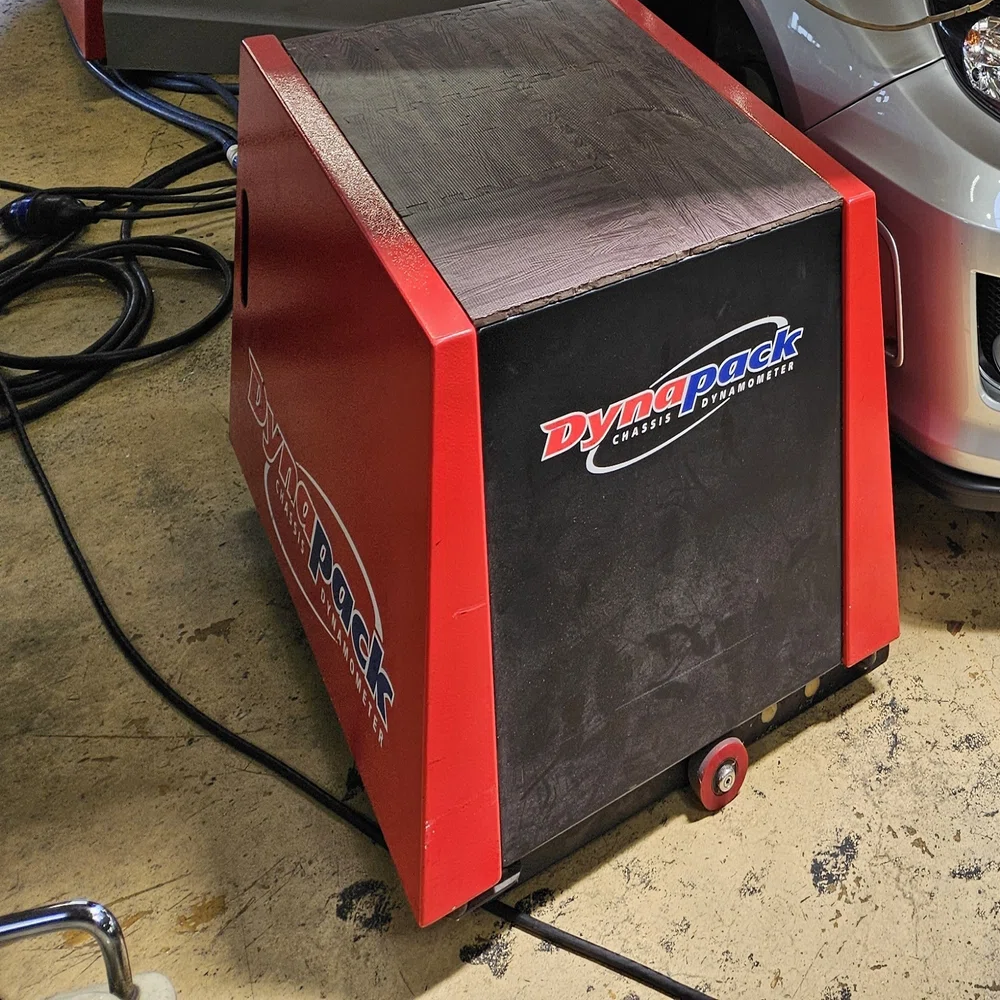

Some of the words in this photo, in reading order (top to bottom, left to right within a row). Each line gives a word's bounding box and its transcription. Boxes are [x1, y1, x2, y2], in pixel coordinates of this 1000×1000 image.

[541, 326, 804, 463] Dynapack
[613, 412, 672, 446] CHASSIS
[701, 361, 795, 408] DYNAMOMETER
[248, 347, 395, 732] Dynapack
[275, 479, 305, 554] CHASSIS
[320, 588, 384, 747] DYNAMOMETER
